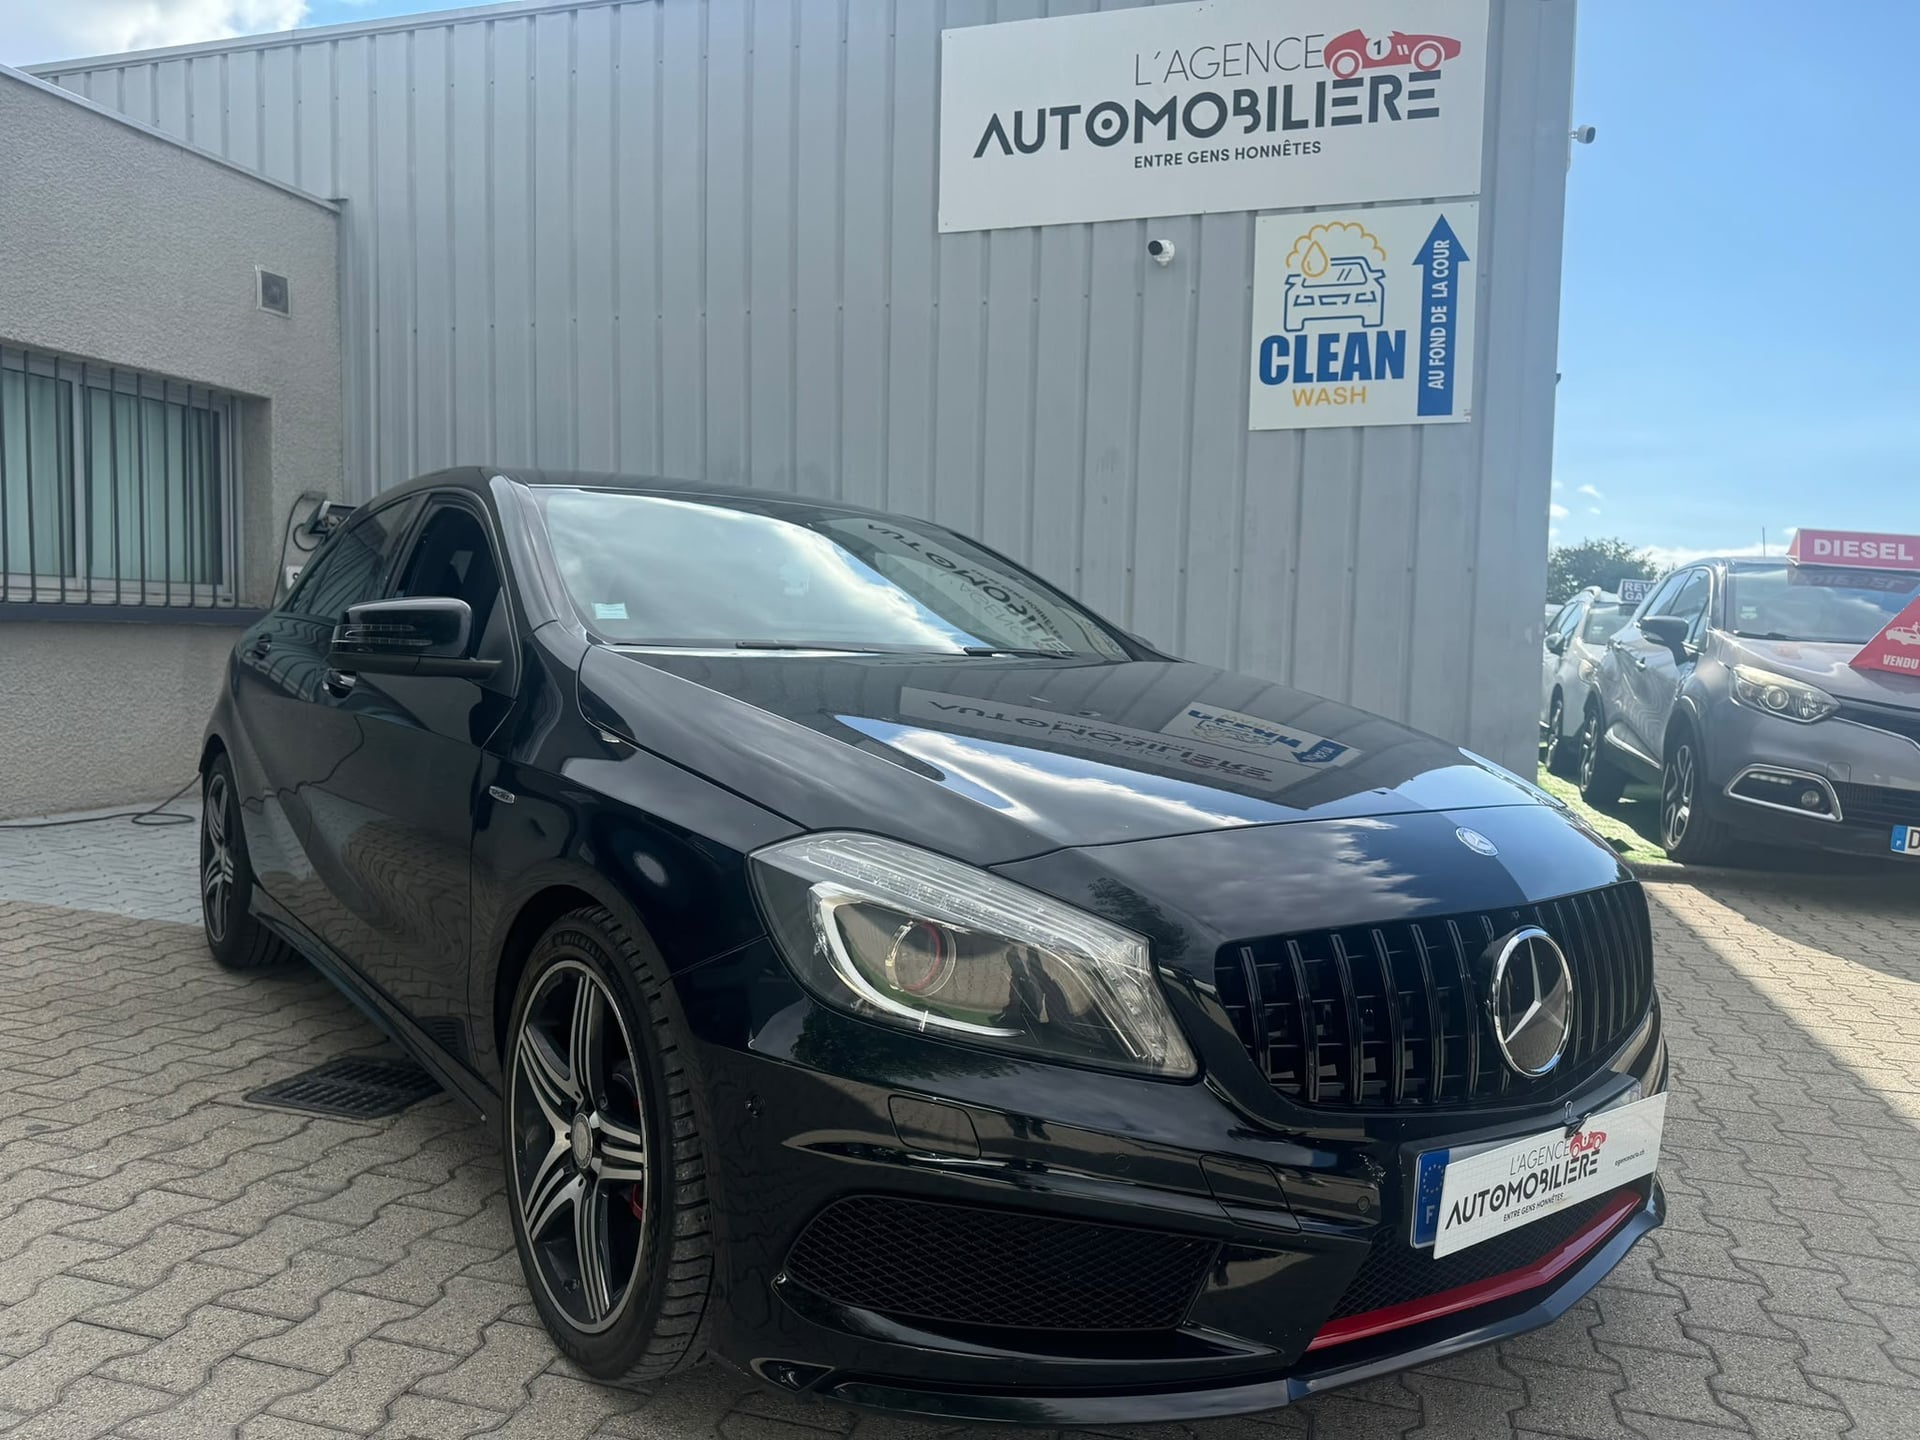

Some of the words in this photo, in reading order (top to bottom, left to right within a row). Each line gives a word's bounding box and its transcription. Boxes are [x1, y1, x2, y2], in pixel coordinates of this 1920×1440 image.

[1134, 151, 1184, 169] ENTRE
[1187, 147, 1231, 164] GENS
[1234, 140, 1322, 161] HONNÊTES
[1432, 239, 1450, 278] COUR
[1431, 280, 1448, 298] LA
[1430, 305, 1447, 323] DE
[1429, 327, 1446, 366] FOND
[1258, 329, 1407, 386] CLEAN
[1428, 371, 1445, 390] AU
[1292, 386, 1367, 407] WASH
[1813, 538, 1914, 562] DIESEL
[1882, 653, 1919, 670] VENDU
[1425, 1204, 1435, 1225] F
[1503, 1208, 1521, 1222] ENTRE
[1521, 1202, 1536, 1215] GENS
